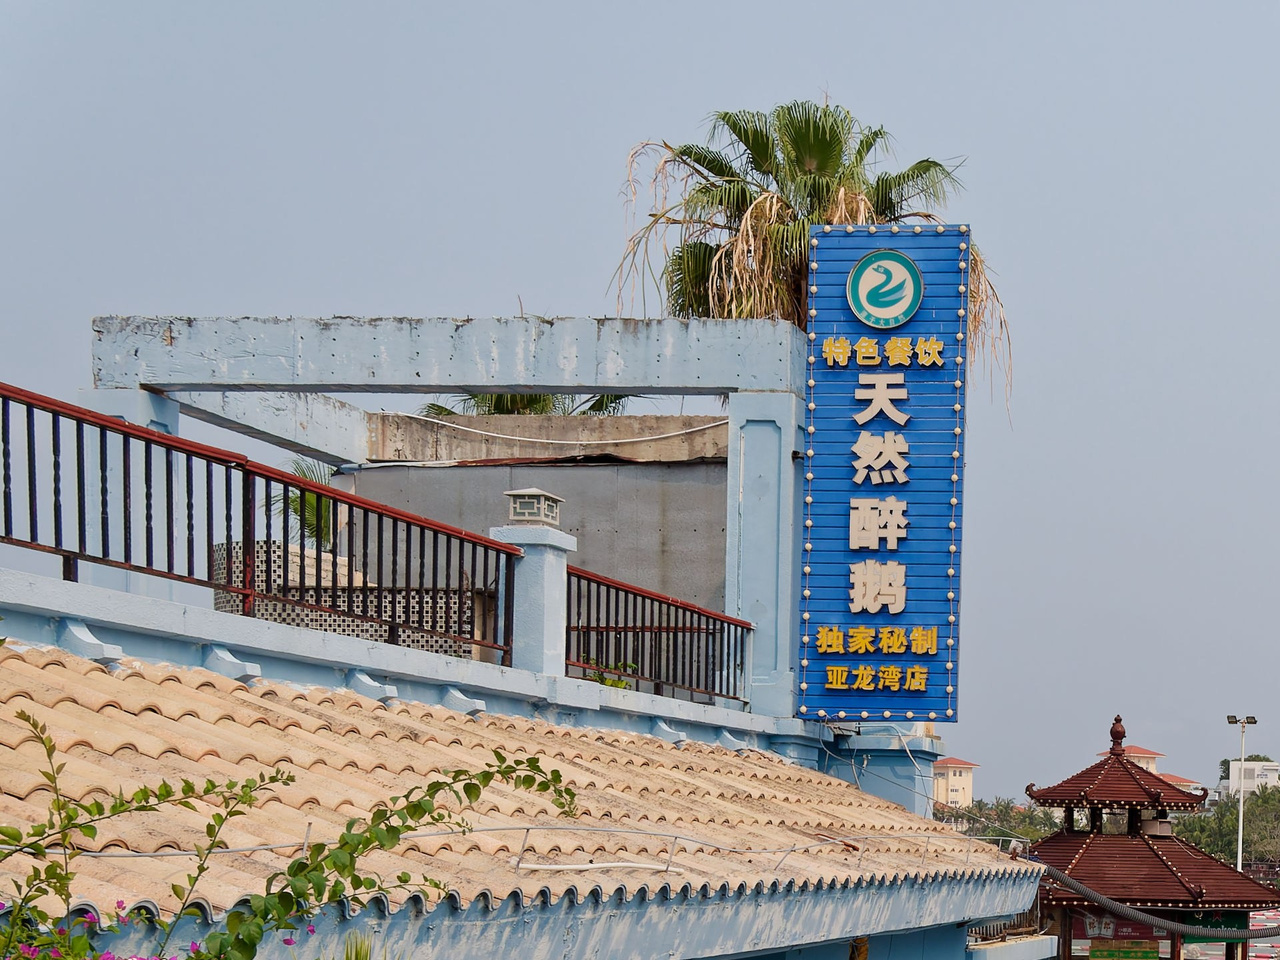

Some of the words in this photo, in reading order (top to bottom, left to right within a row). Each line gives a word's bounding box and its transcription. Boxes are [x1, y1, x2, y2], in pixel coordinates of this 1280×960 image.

[822, 336, 944, 367] 特色餐饮
[848, 372, 911, 614] 天然醉鹅
[815, 625, 939, 655] 独家秘制
[824, 665, 930, 692] 亚龙湾店
